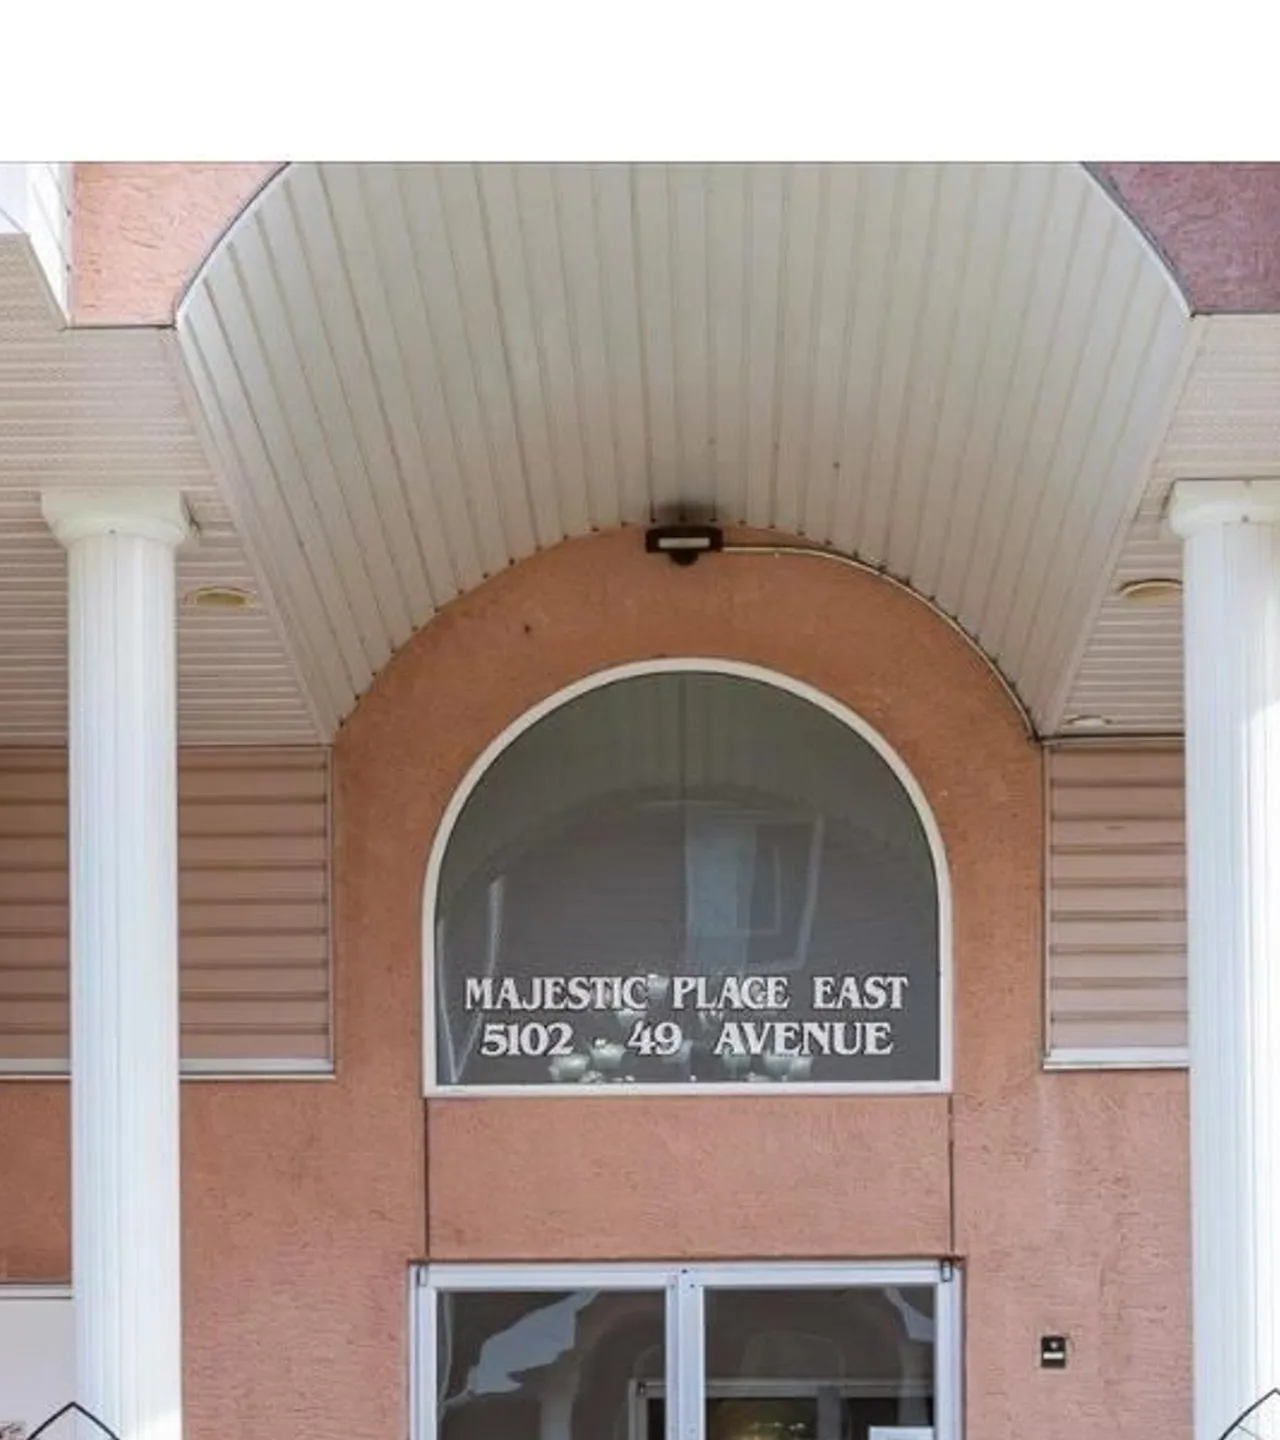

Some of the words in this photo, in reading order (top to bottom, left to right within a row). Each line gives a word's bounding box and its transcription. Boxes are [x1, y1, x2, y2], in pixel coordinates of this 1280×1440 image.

[466, 976, 648, 1010] MAJESTIC
[672, 976, 790, 1010] PLACE
[813, 976, 909, 1010] EAST
[481, 1021, 574, 1056] 5102
[628, 1020, 683, 1056] 49
[713, 1021, 893, 1056] AVENUE
